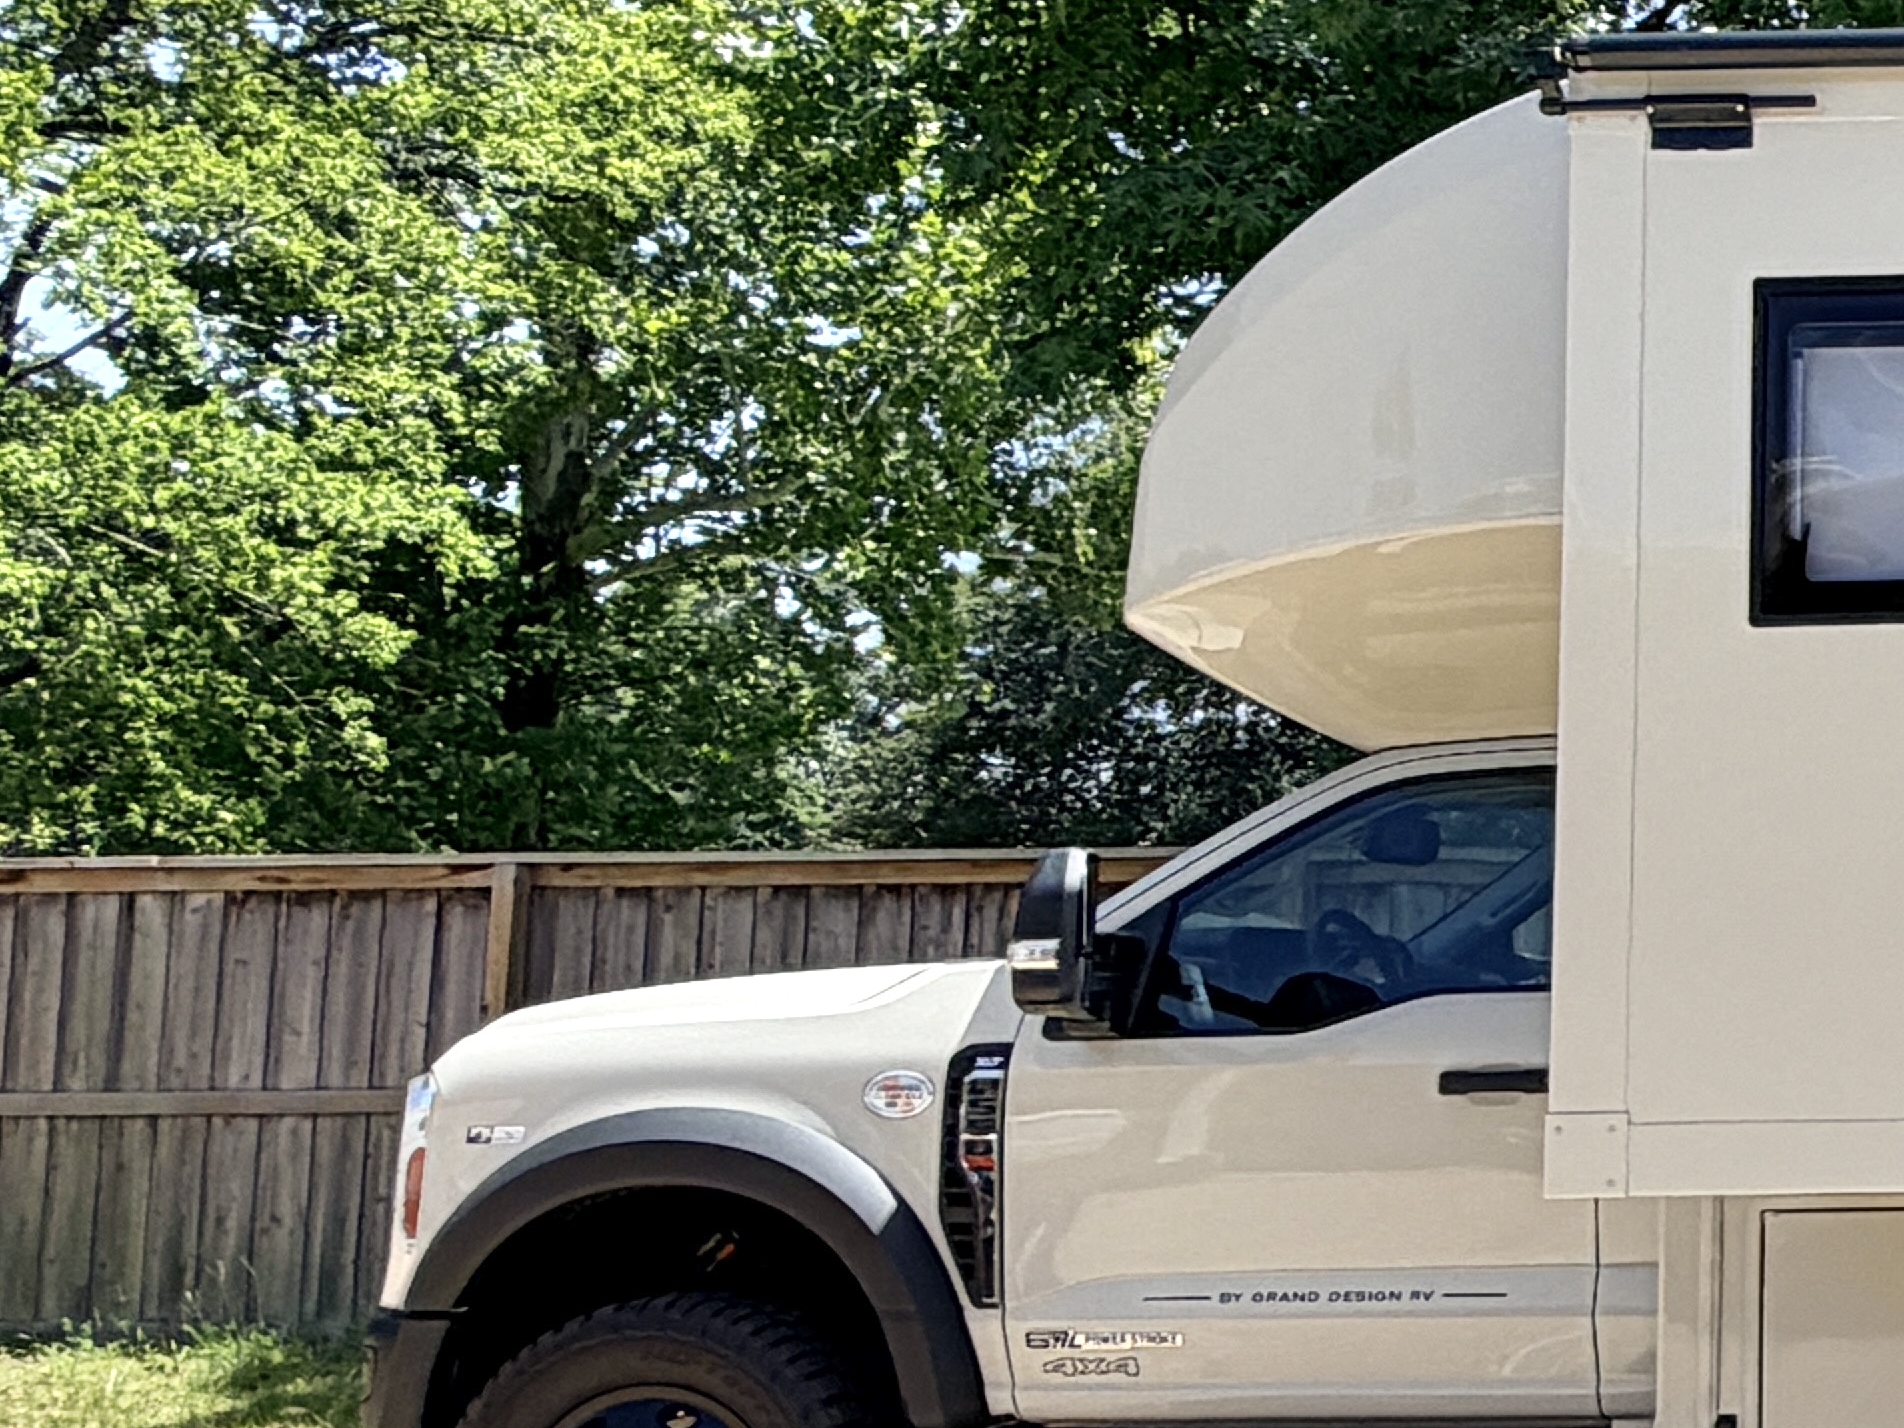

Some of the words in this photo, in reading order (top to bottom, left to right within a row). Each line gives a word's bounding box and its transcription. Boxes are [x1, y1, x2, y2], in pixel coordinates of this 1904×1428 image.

[1218, 1291, 1243, 1304] BY
[1250, 1290, 1321, 1304] GRAND
[1327, 1289, 1403, 1303] DESIGN
[1409, 1289, 1436, 1302] RV
